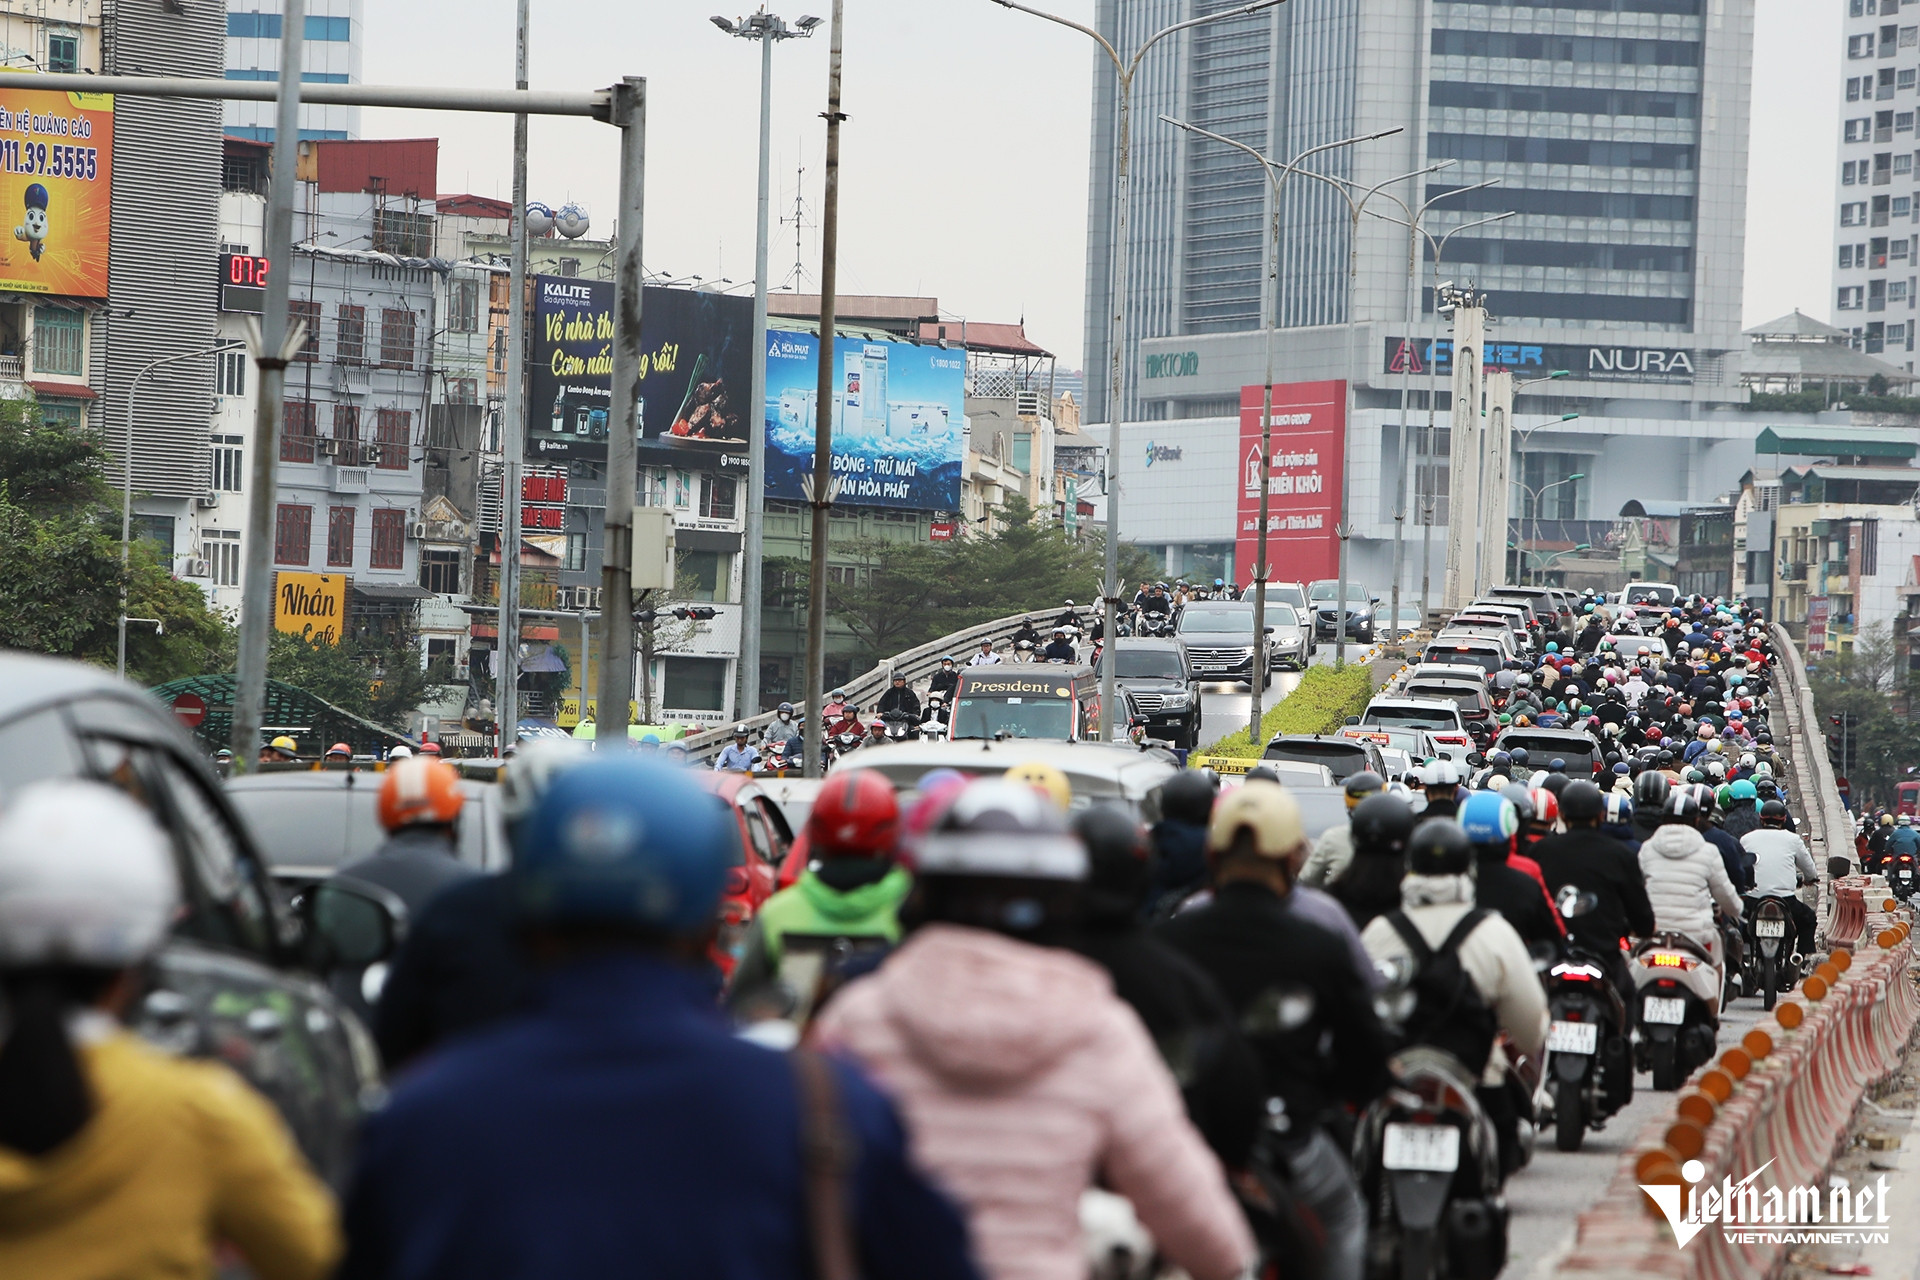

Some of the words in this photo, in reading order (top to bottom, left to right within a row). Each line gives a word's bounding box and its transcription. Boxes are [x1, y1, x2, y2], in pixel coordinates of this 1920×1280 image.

[15, 107, 31, 137] HỆ
[32, 111, 68, 136] QUẢNG
[70, 115, 92, 140] CÁO
[231, 256, 269, 287] 072
[544, 283, 591, 299] KALITE
[546, 310, 565, 342] Về
[565, 312, 595, 341] nhà
[587, 344, 613, 375] nấu
[652, 342, 679, 371] rồi!
[949, 360, 961, 369] 1022
[1425, 342, 1543, 365] CBER
[1589, 348, 1694, 373] NURA
[567, 385, 582, 394] Combo
[547, 442, 568, 450] kalite.vn
[728, 457, 740, 465] 1900
[833, 453, 865, 473] ĐÔNG
[874, 455, 895, 475] TRỮ
[895, 458, 918, 476] MÁT
[858, 477, 881, 497] HÒA
[883, 480, 910, 498] PHÁT
[1295, 469, 1323, 494] KHÔI
[522, 504, 540, 526] TÂY
[281, 583, 337, 617] Nhân
[969, 680, 1050, 694] President
[564, 704, 577, 715] Xôi
